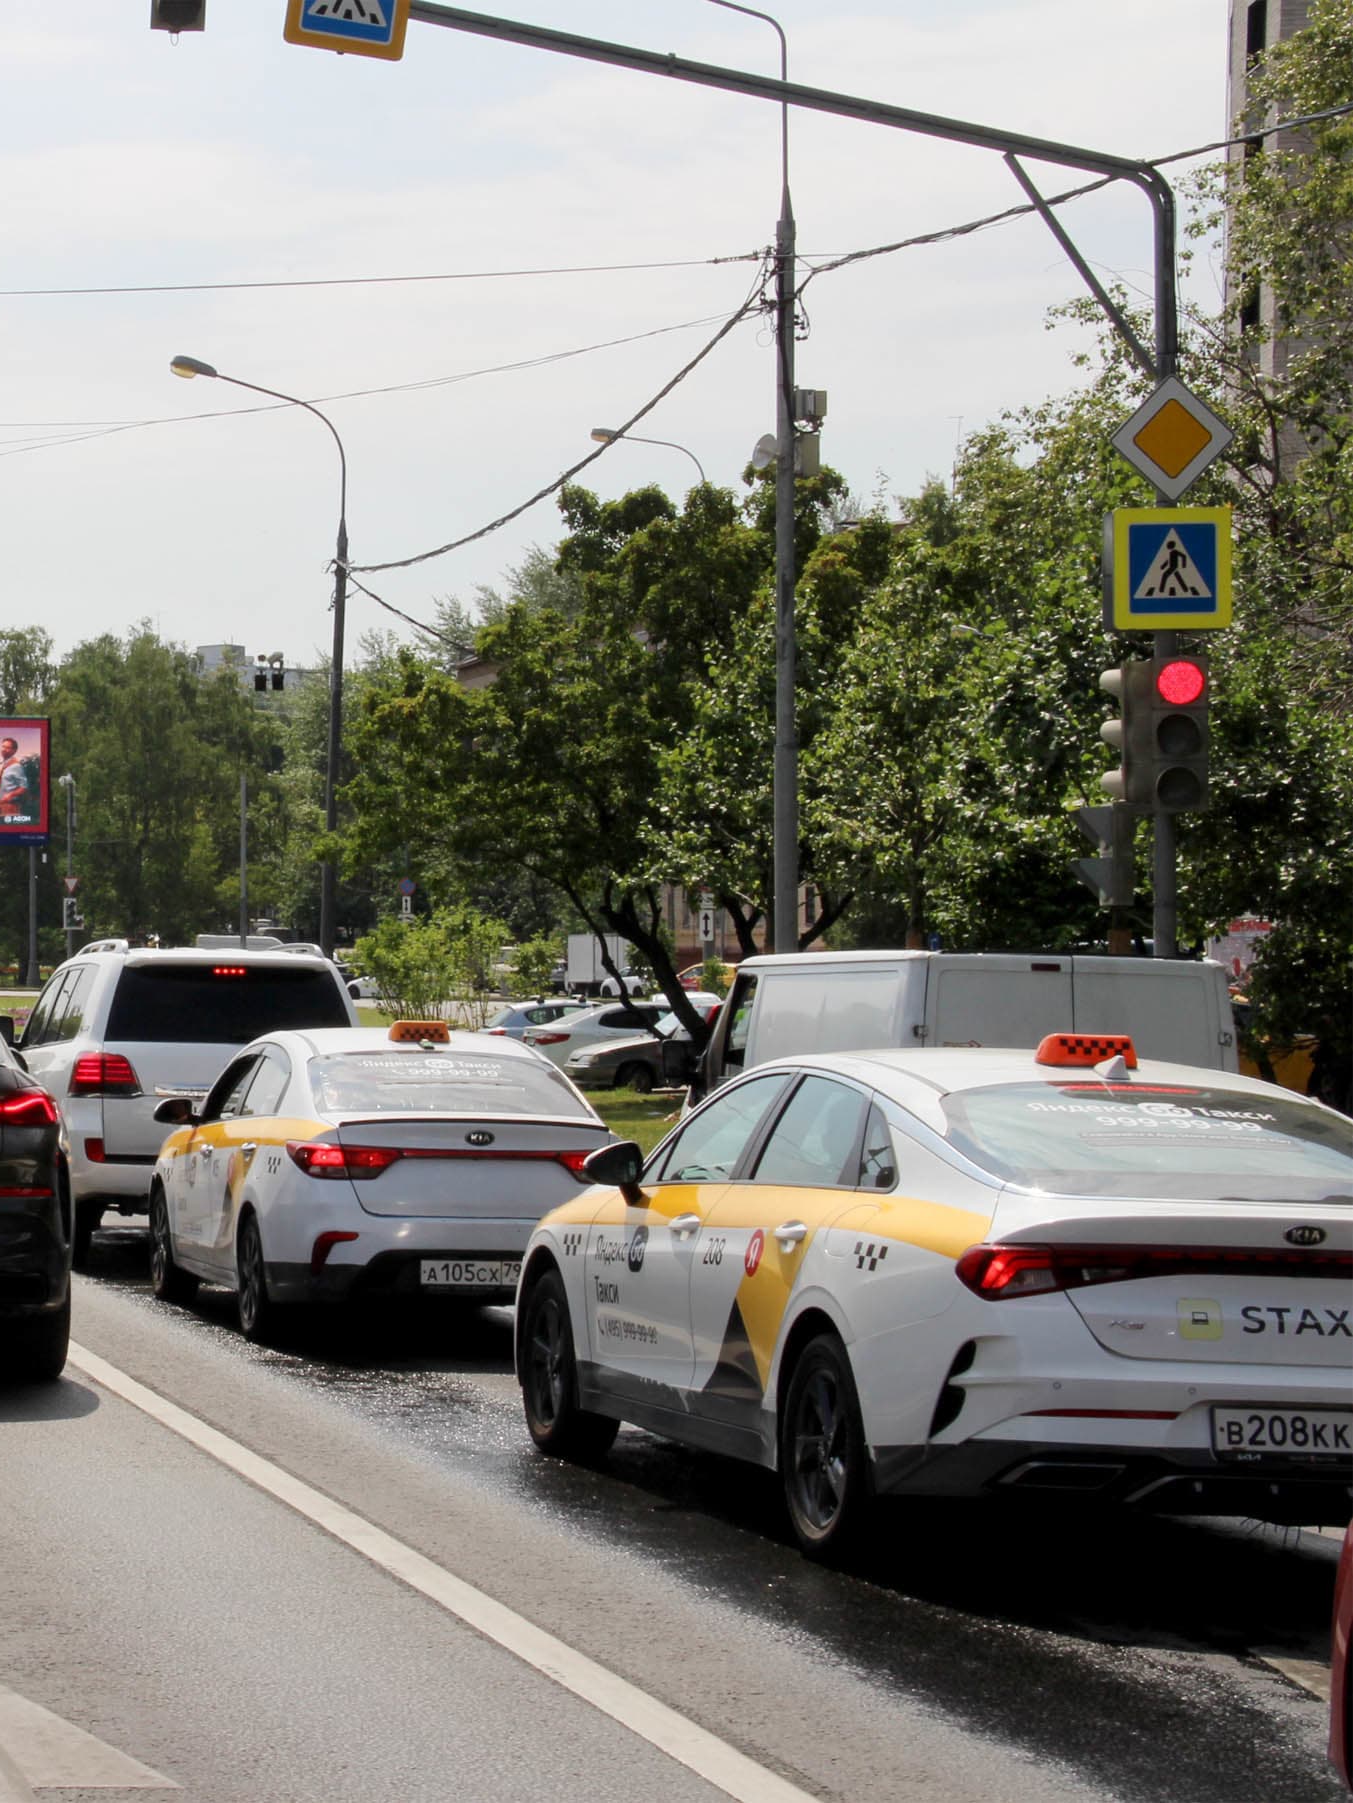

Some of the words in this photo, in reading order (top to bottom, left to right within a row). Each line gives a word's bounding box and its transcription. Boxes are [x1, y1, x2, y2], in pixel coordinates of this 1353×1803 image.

[1026, 1102, 1137, 1112] Яндекс
[1191, 1106, 1277, 1121] Такси
[1095, 1116, 1263, 1132] 999-99-99
[470, 1133, 490, 1142] KIA
[1290, 1229, 1321, 1243] KIA
[595, 1234, 629, 1265] Яндекс
[702, 1238, 726, 1266] 208
[427, 1263, 499, 1282] А105СХ
[503, 1263, 522, 1278] 79
[594, 1275, 620, 1305] Такси
[605, 1318, 623, 1341] (495)
[623, 1321, 658, 1344] 999-99-99
[1241, 1306, 1353, 1337] STAX
[1226, 1415, 1351, 1448] В208КК
